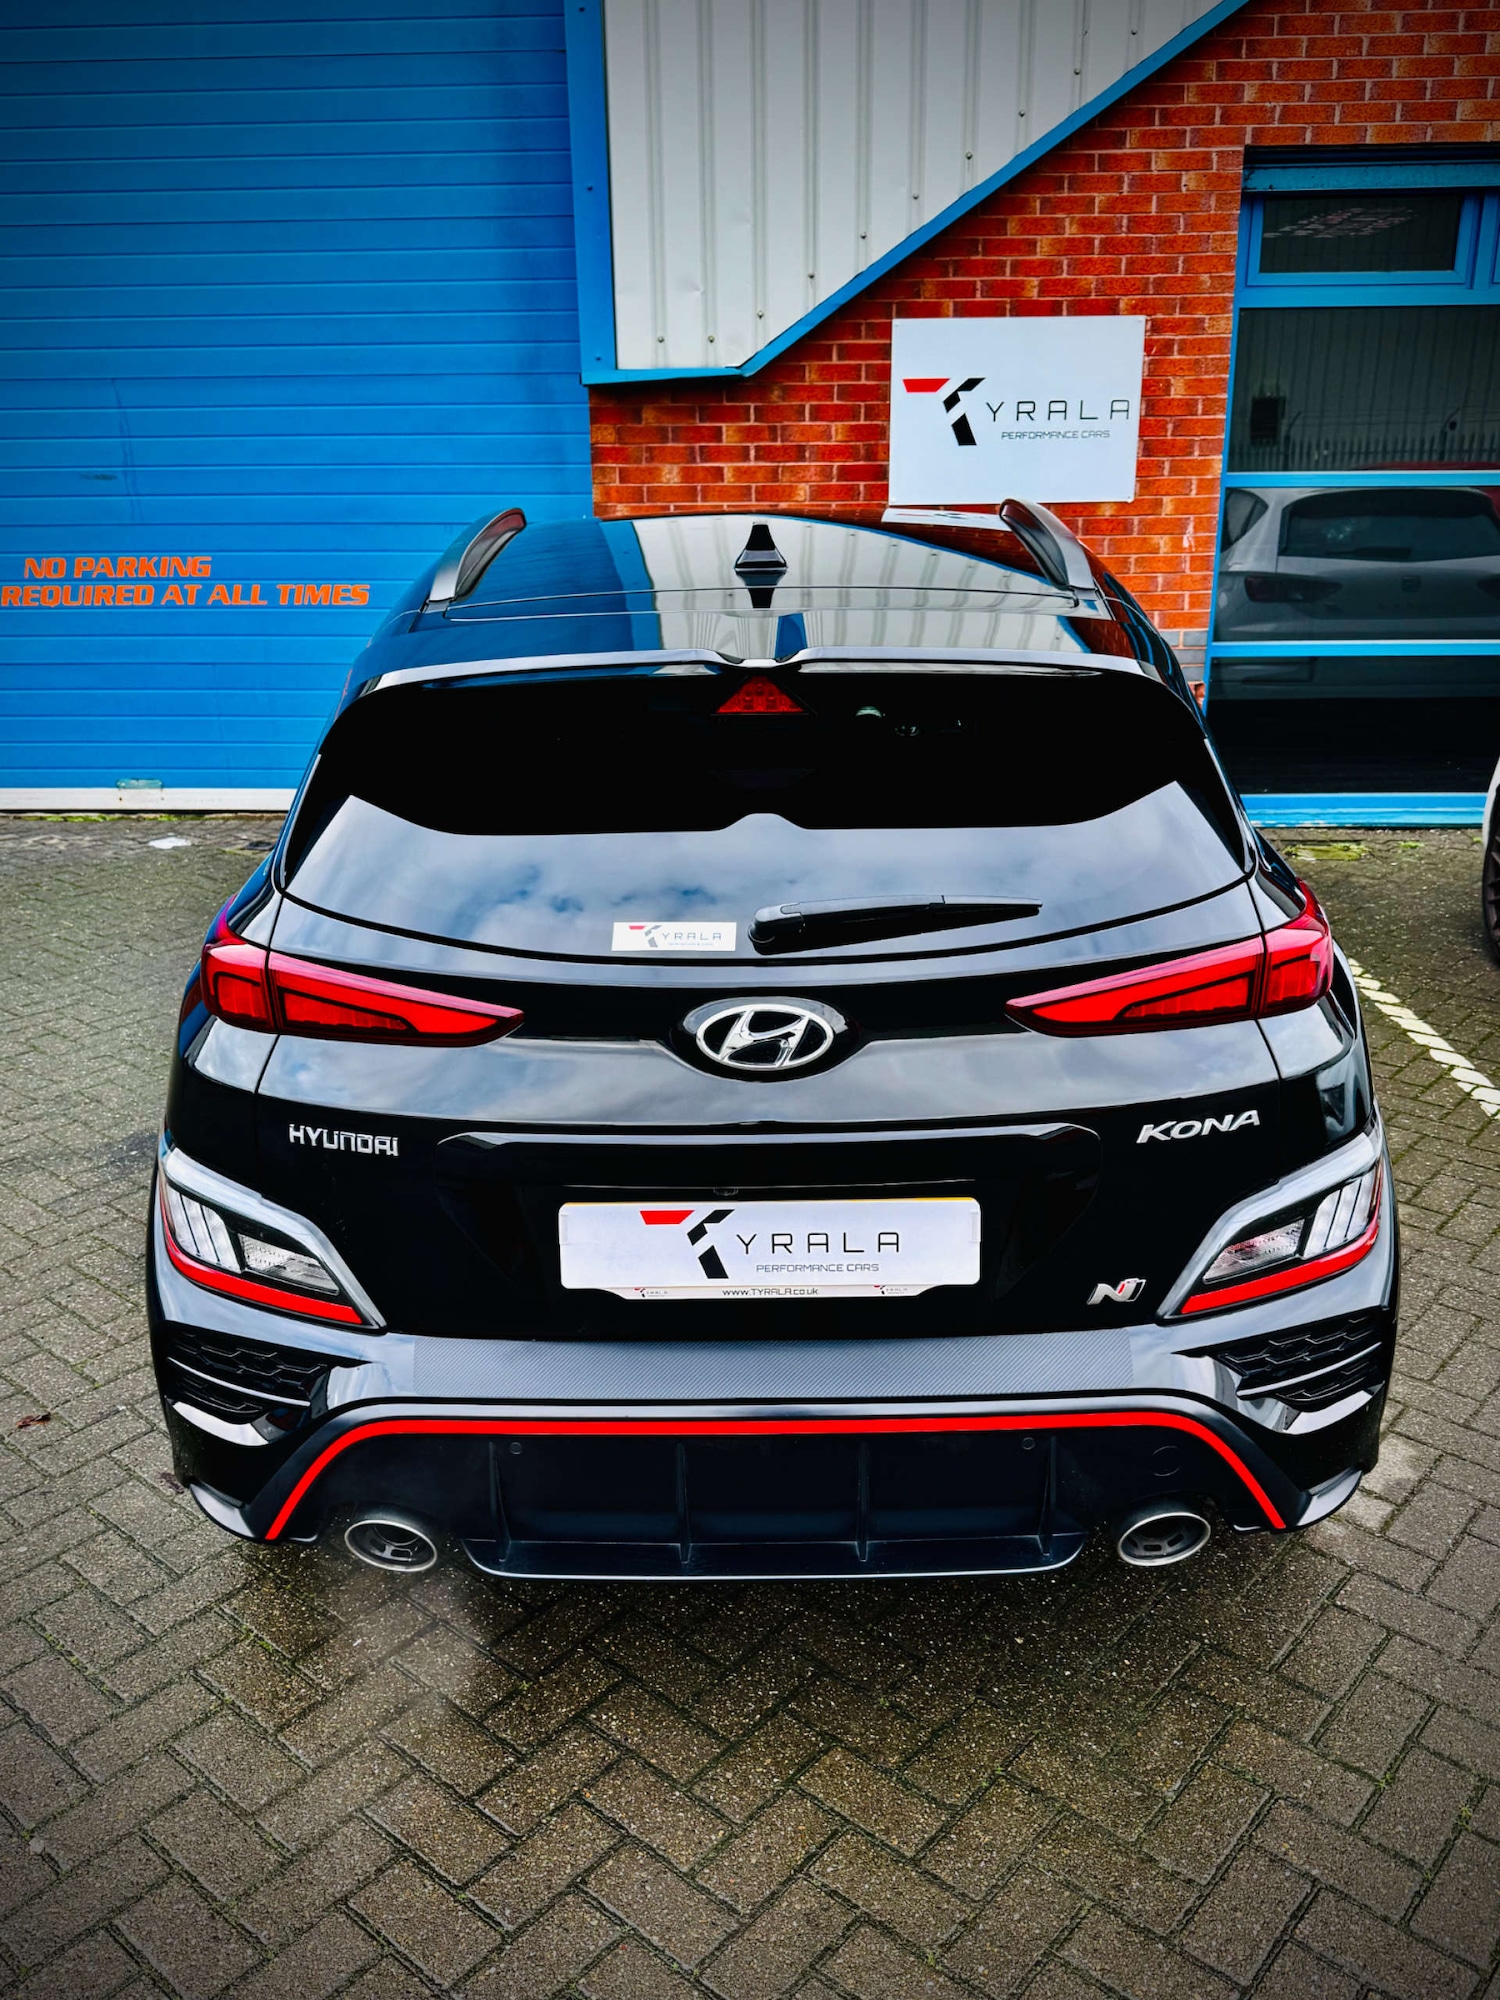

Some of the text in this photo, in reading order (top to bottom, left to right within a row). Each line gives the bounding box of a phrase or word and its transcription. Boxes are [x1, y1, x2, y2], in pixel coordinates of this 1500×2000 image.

[1001, 429, 1111, 440] PERFORMANCE CARS
[24, 556, 212, 579] NO PARKING
[1, 584, 370, 608] REQUIRED AT ALL TIMES
[1136, 1109, 1261, 1144] KONA
[288, 1123, 400, 1157] HYUNDAI
[756, 1262, 880, 1273] PERFORMANCE CARS
